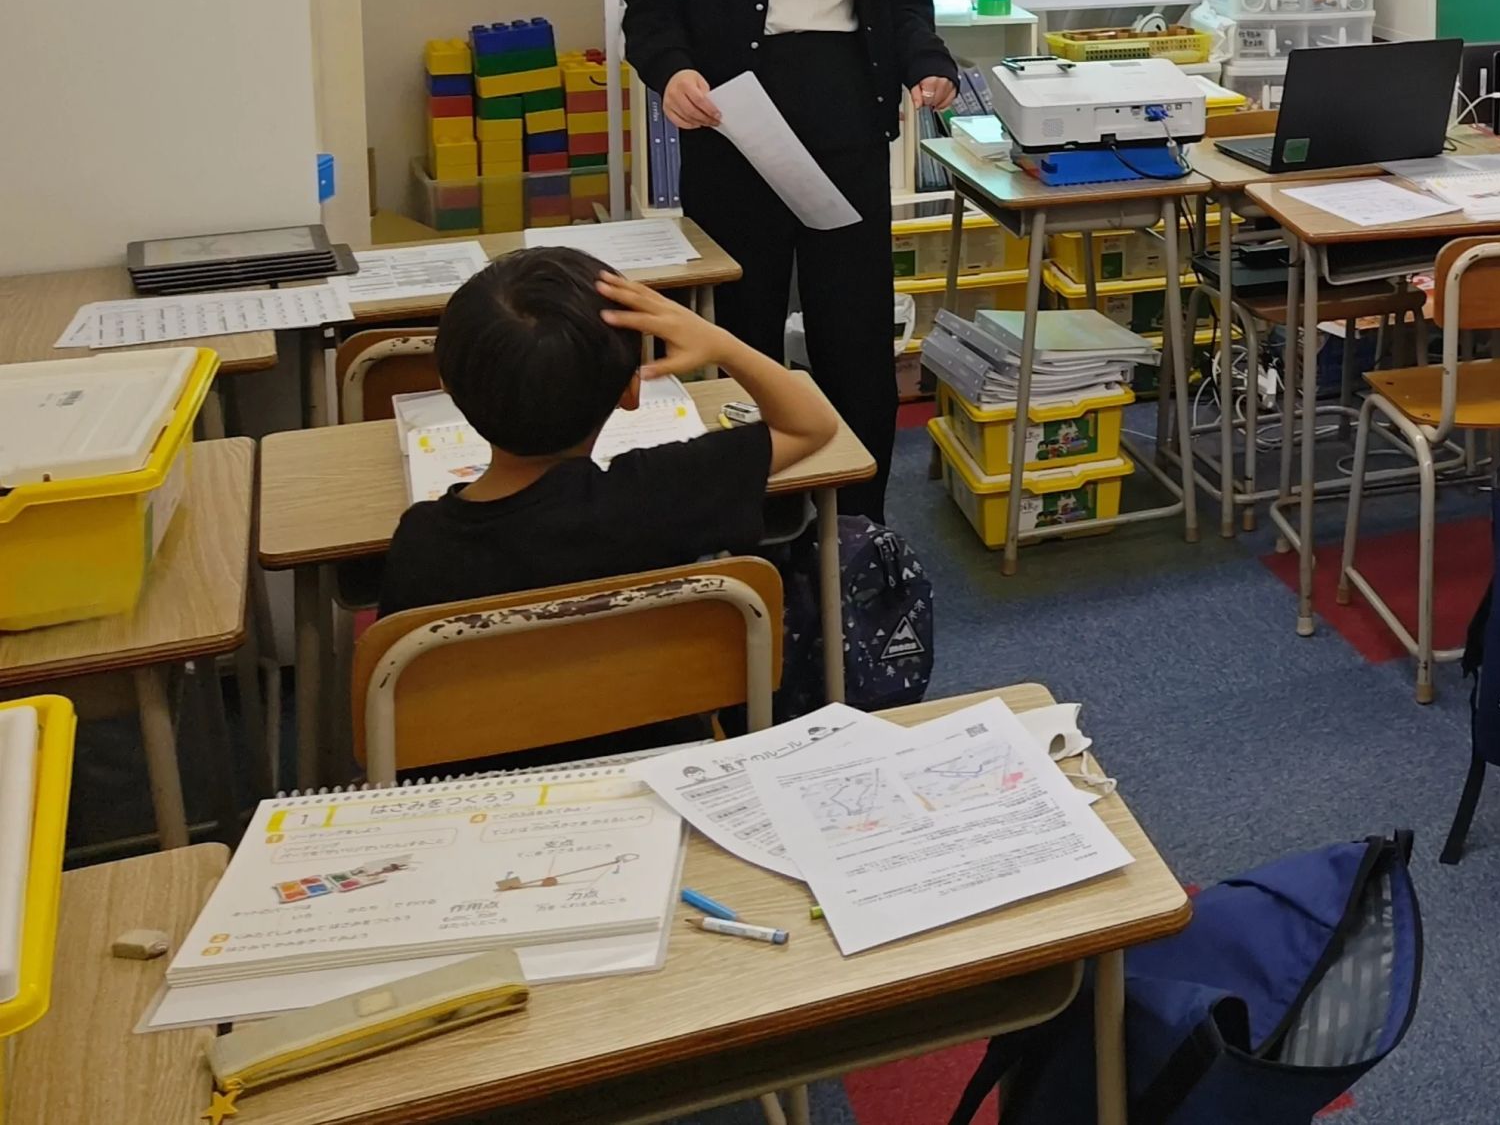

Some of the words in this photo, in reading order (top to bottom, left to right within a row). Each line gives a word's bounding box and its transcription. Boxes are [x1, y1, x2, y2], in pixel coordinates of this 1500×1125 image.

[370, 791, 515, 815] はさみをつくろう
[301, 814, 309, 825] 1
